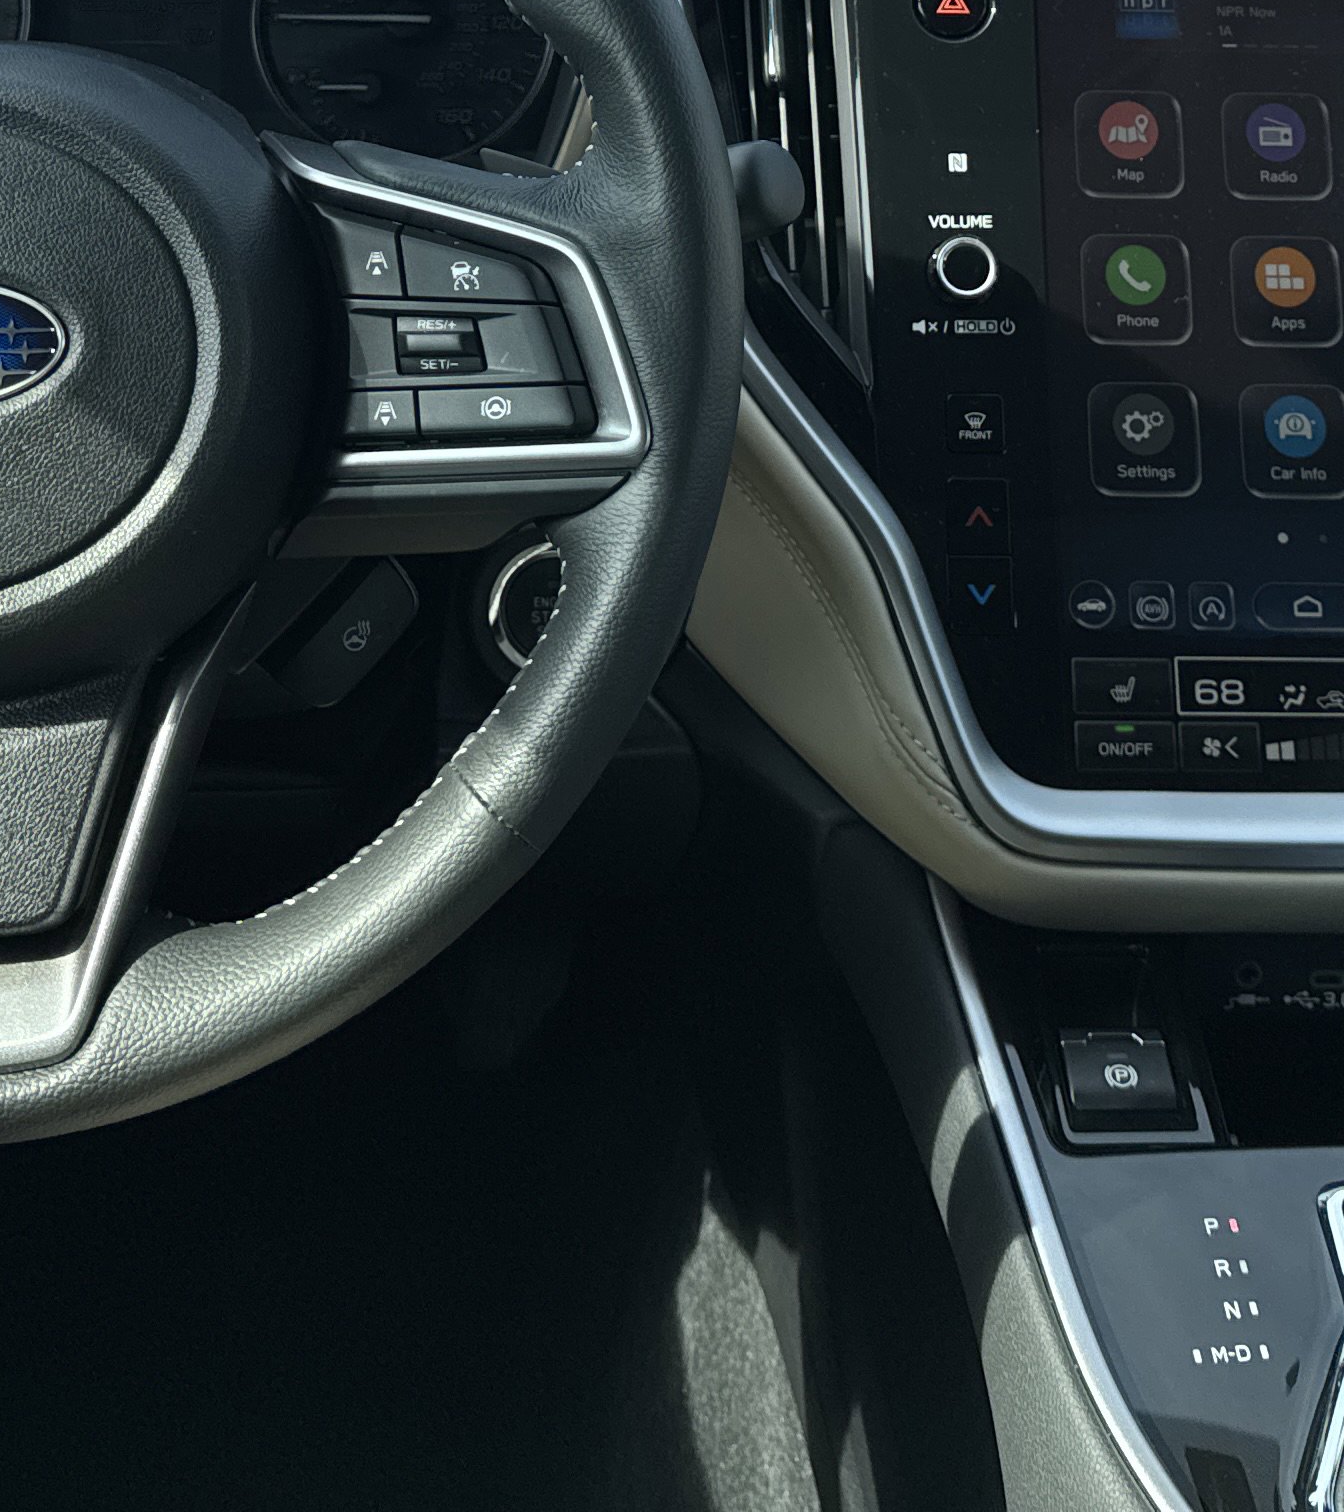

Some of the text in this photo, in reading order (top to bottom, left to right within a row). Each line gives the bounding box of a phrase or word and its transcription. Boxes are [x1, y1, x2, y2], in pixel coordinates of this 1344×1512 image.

[1216, 6, 1277, 19] NPR Now
[1117, 168, 1145, 183] Map
[1259, 169, 1298, 184] Radio
[928, 214, 993, 229] VOLUME
[956, 320, 997, 333] HOLD
[1117, 314, 1160, 328] Phone
[1271, 316, 1306, 331] Apps
[958, 429, 993, 441] FRONT
[1116, 464, 1176, 481] Settings
[1270, 466, 1327, 481] Car Info
[1193, 678, 1246, 707] 68
[1098, 741, 1153, 758] ON/OFF
[1203, 1218, 1219, 1237] P
[1213, 1259, 1232, 1278] R
[1223, 1300, 1242, 1321] N
[1210, 1345, 1252, 1364] M-D
